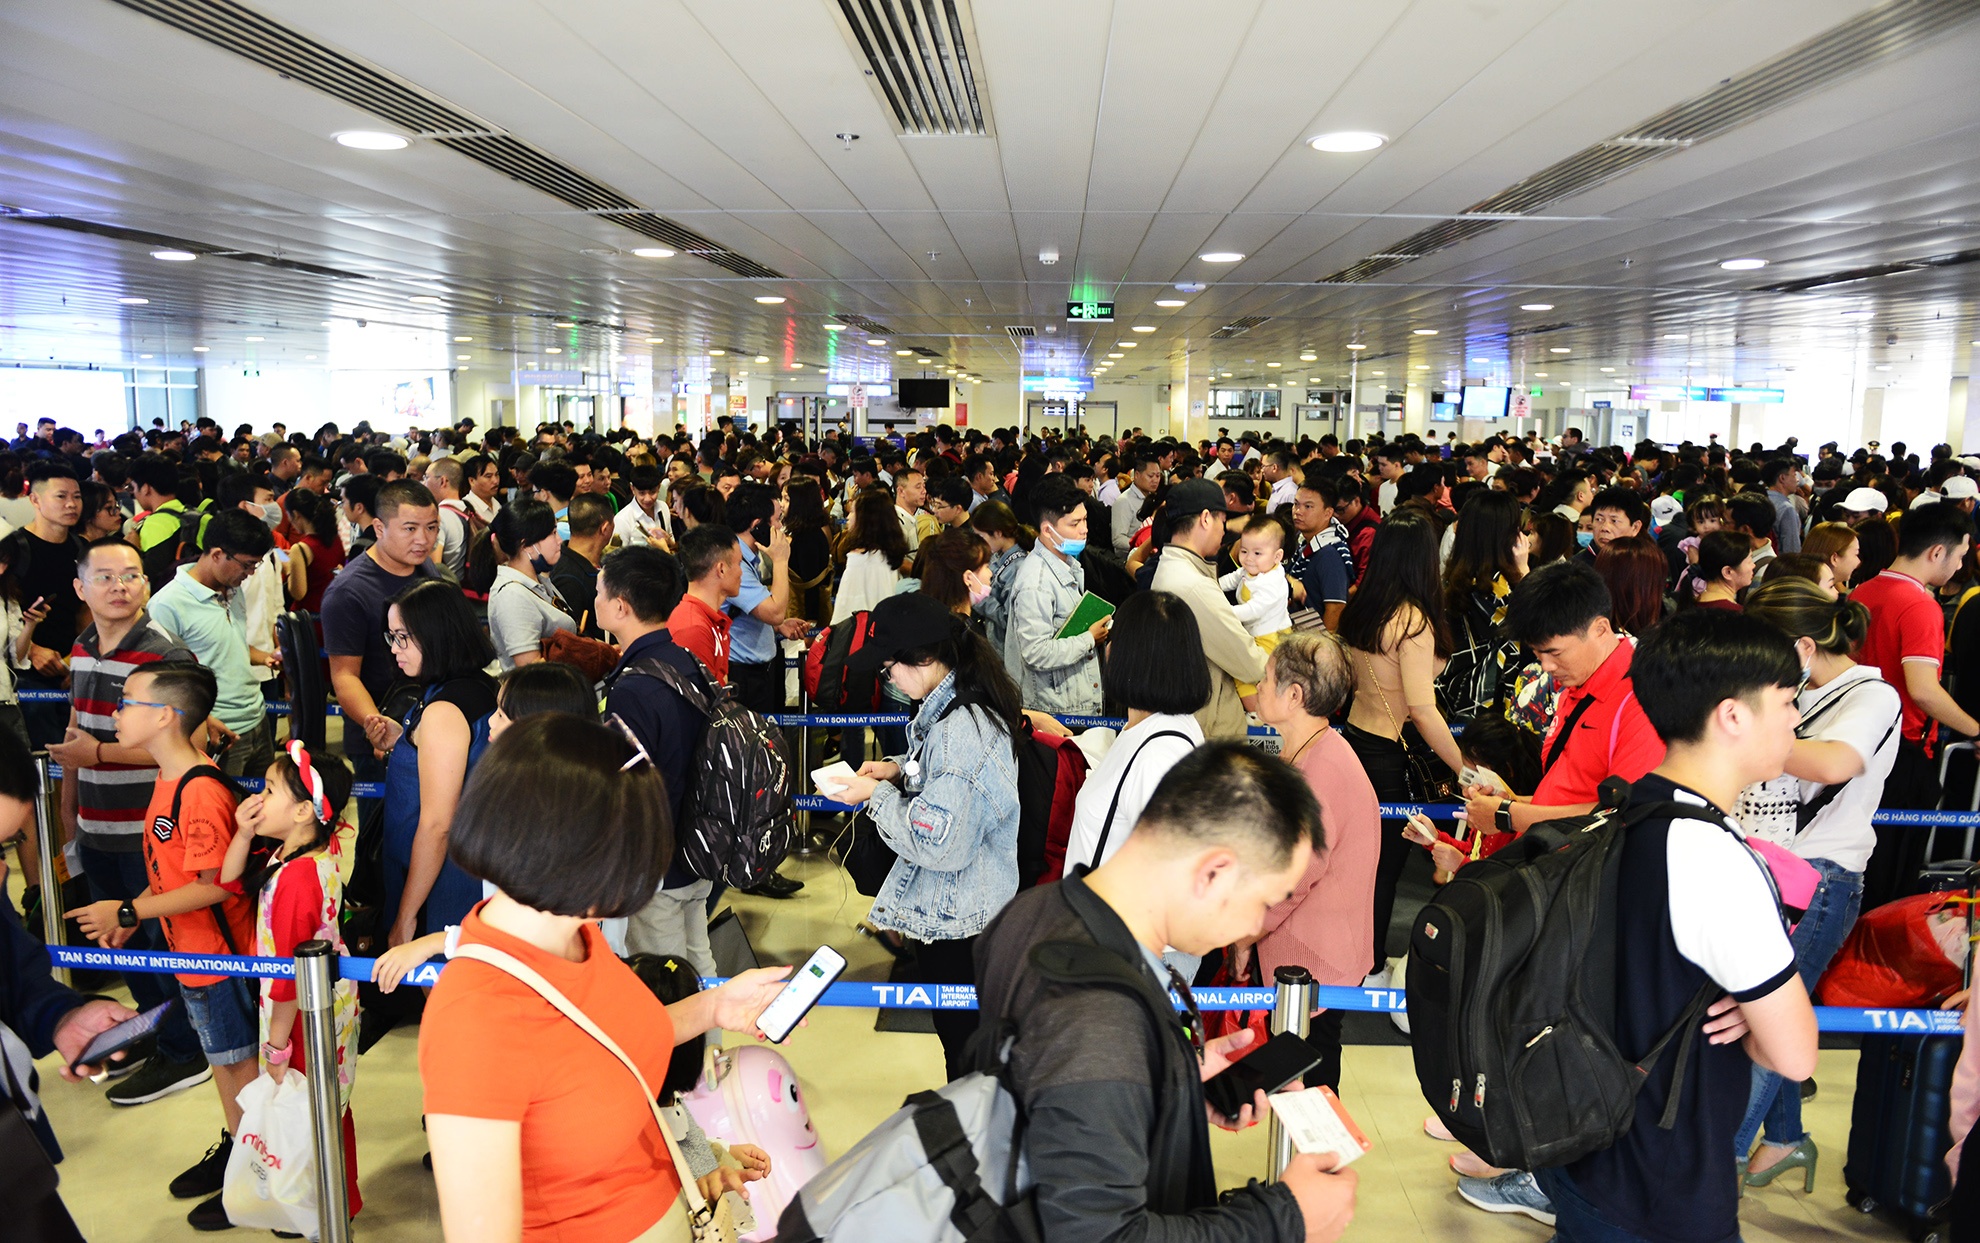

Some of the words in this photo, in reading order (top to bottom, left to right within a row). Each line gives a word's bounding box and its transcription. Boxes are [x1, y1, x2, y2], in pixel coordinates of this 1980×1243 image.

[1109, 719, 1126, 727] KHÔ
[796, 796, 823, 808] NHẤT
[1922, 813, 1957, 822] KHÔNG
[58, 951, 82, 963] TAN
[85, 953, 112, 965] SON
[114, 954, 147, 967] NHAT
[150, 957, 249, 972] INTERNATIONAL
[406, 965, 439, 983] IA
[872, 986, 932, 1005] TIA
[1229, 993, 1276, 1004] AIRPO
[1864, 1010, 1928, 1029] TIA
